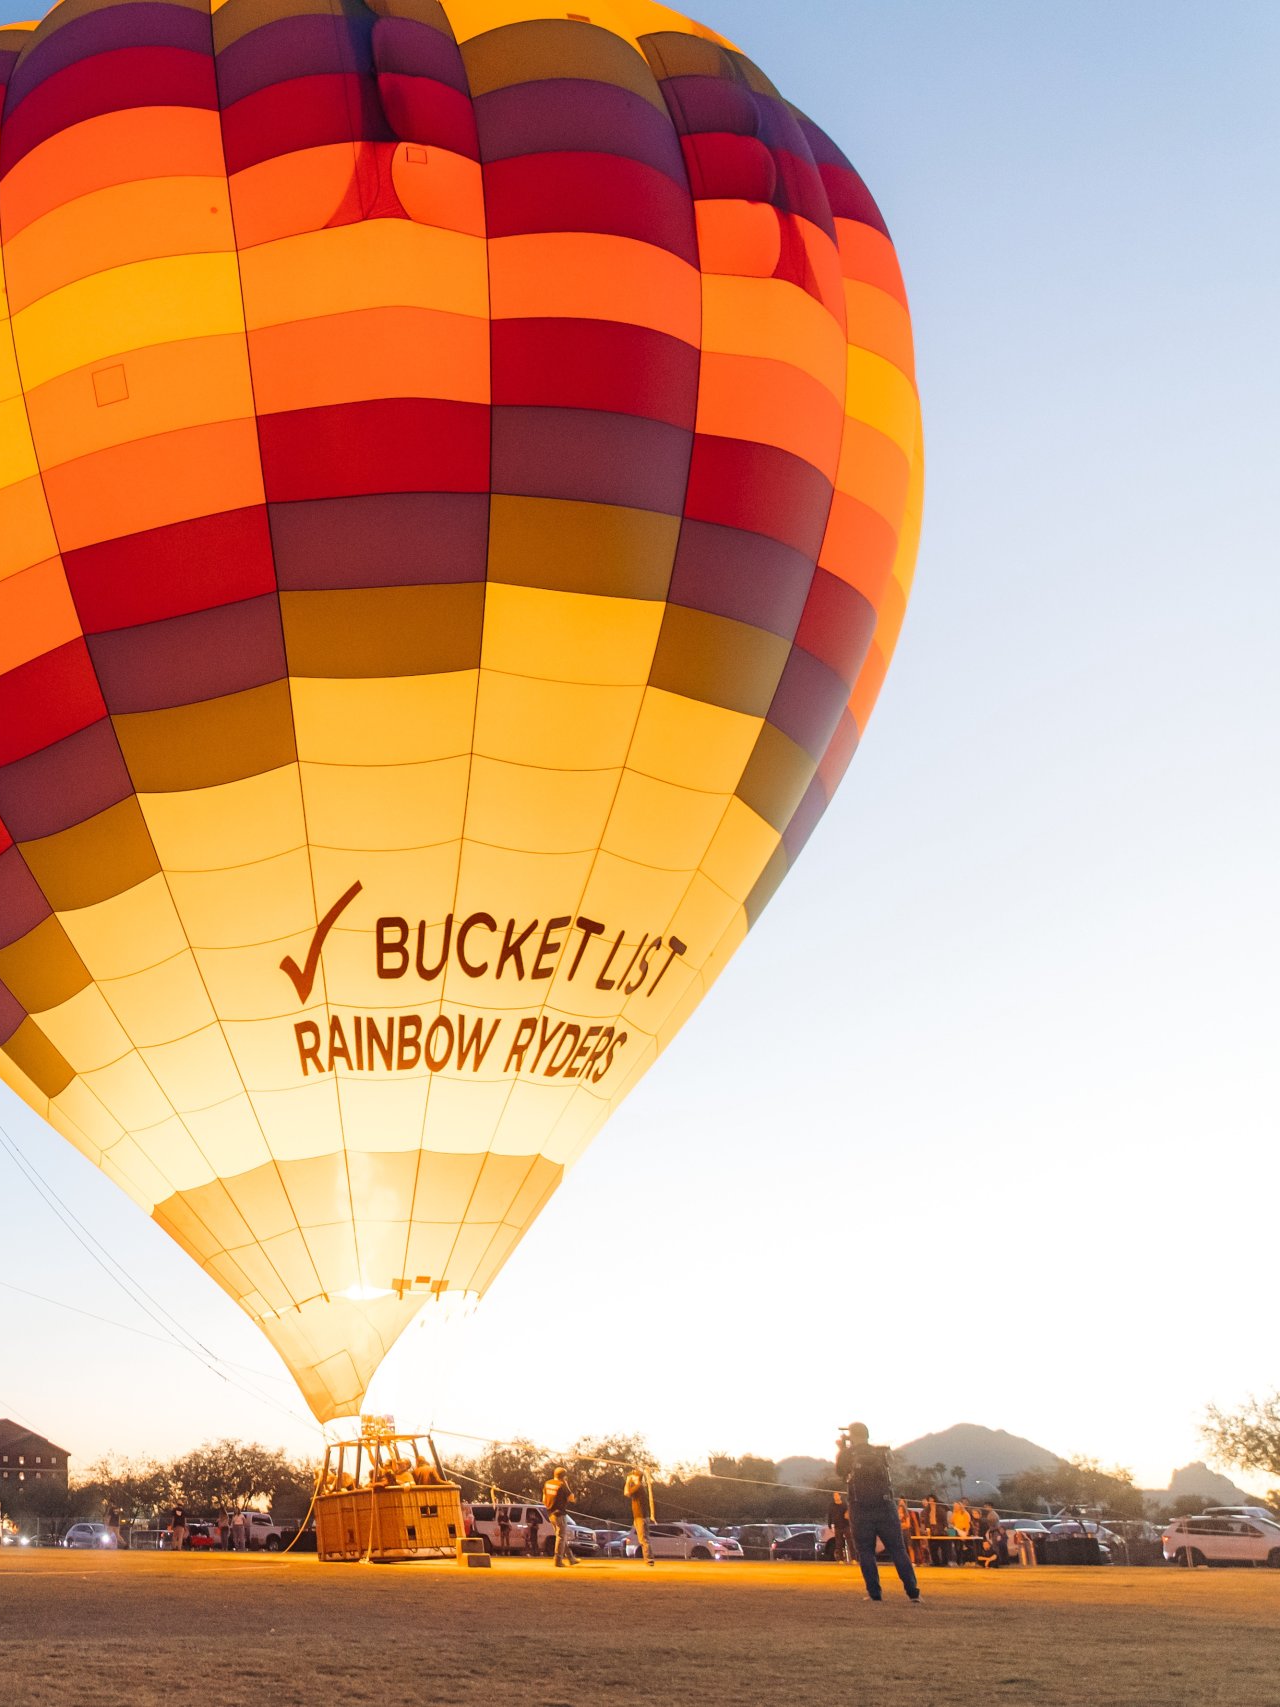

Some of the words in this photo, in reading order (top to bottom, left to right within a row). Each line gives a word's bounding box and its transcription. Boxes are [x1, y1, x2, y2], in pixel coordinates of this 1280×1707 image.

[375, 912, 606, 982] BUCKET
[595, 930, 688, 998] LIST
[293, 1013, 501, 1077] RAINBOW
[503, 1015, 628, 1084] RYDERS
